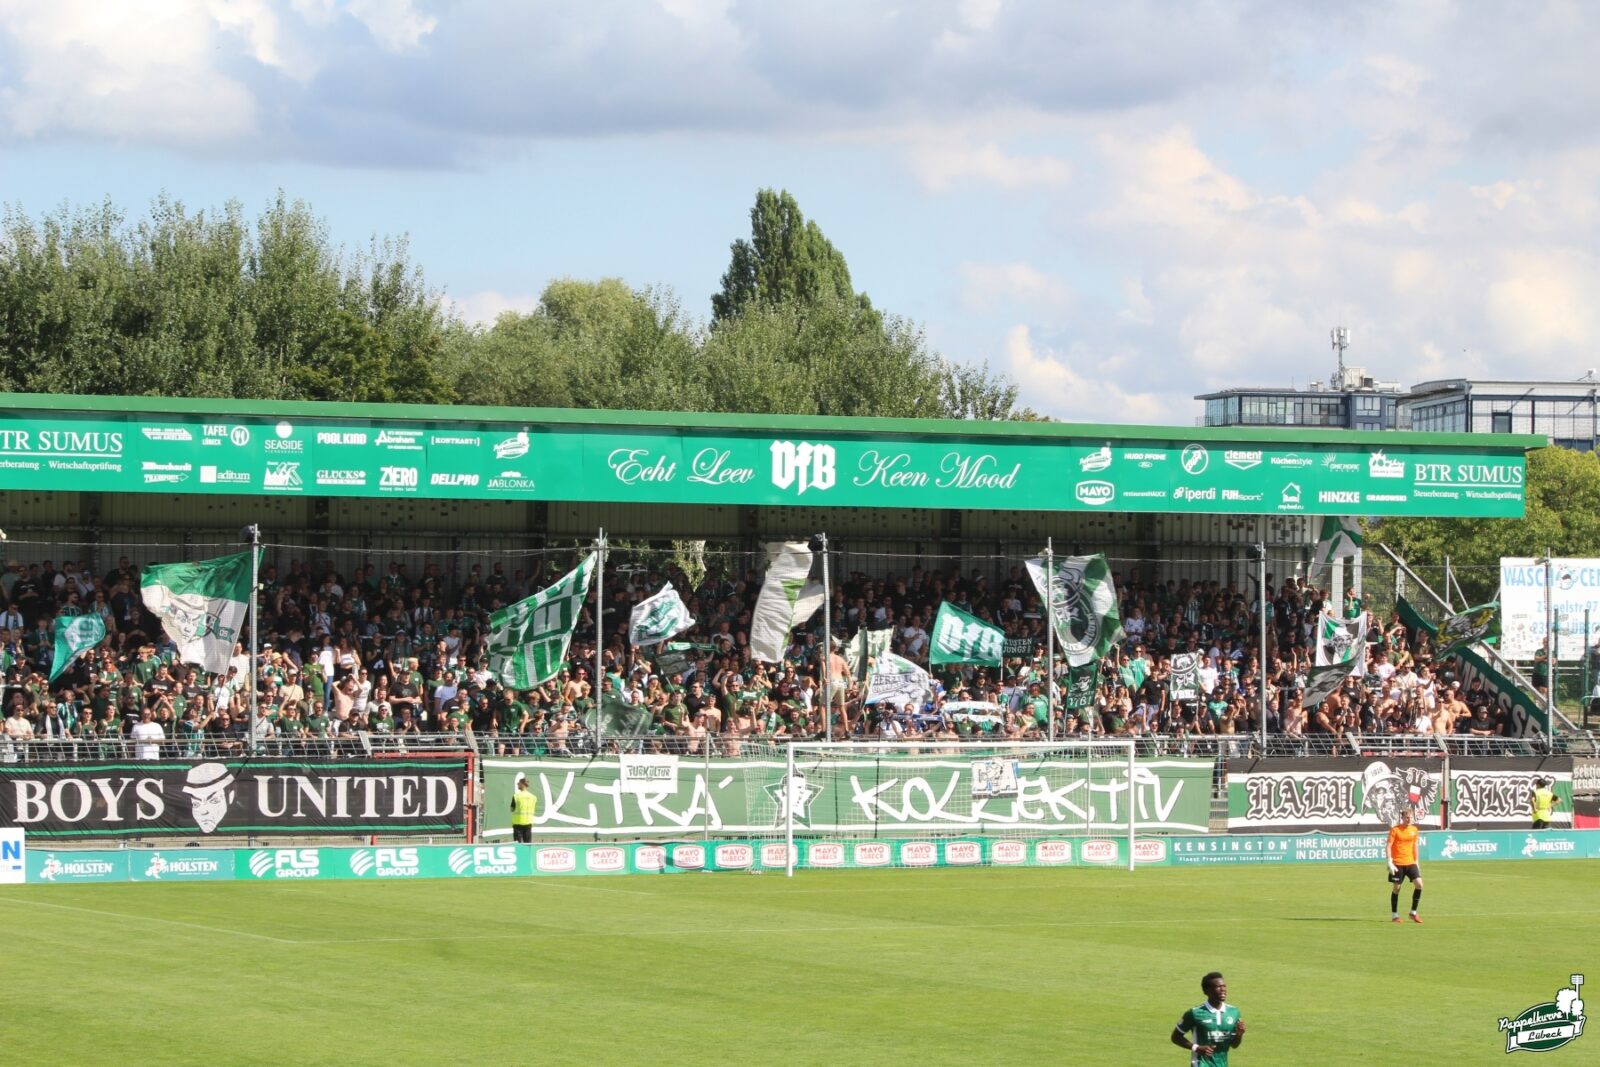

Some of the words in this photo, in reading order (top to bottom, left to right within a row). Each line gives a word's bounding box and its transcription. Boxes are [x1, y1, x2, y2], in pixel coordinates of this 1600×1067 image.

[202, 425, 227, 436] TAFEL
[0, 430, 31, 450] TR
[38, 431, 122, 452] SUMUS
[264, 440, 303, 450] SEASIDE
[1224, 450, 1263, 459] clement
[0, 460, 39, 471] erberatung
[48, 461, 122, 472] Wirtschaftsprüfung
[608, 448, 677, 485] Echt
[687, 448, 755, 485] Leev
[853, 450, 930, 488] Keen
[936, 453, 1021, 489] Mood
[1414, 463, 1452, 482] BTR
[1458, 465, 1522, 483] SUMUS
[430, 473, 480, 486] DELLPRO
[487, 479, 536, 488] JABLONKA
[1079, 486, 1111, 497] MAYO
[1185, 487, 1216, 502] iperdi
[1318, 491, 1361, 503] HINZKE
[1414, 489, 1459, 499] Steuerberatung
[1465, 490, 1522, 501] Wirtschaftsprüfung
[12, 777, 164, 823] BOYS
[254, 774, 458, 820] UNITED
[1174, 841, 1288, 852] KENSINGTON
[1296, 838, 1318, 849] IHRE
[1460, 842, 1498, 853] HOLSTEN
[1539, 841, 1575, 851] HOLSTEN
[274, 848, 320, 869] FLS
[375, 847, 419, 868] FLS
[473, 847, 517, 866] FLS
[543, 851, 569, 859] MAYO
[1296, 850, 1306, 860] IN
[1308, 850, 1328, 859] DER
[1330, 848, 1379, 859] LÜBECKER
[65, 862, 112, 874] HOLSTEN
[170, 861, 217, 873] HOLSTEN
[275, 868, 320, 878] GROUP
[376, 867, 419, 877] GROUP
[474, 865, 517, 875] GROUP
